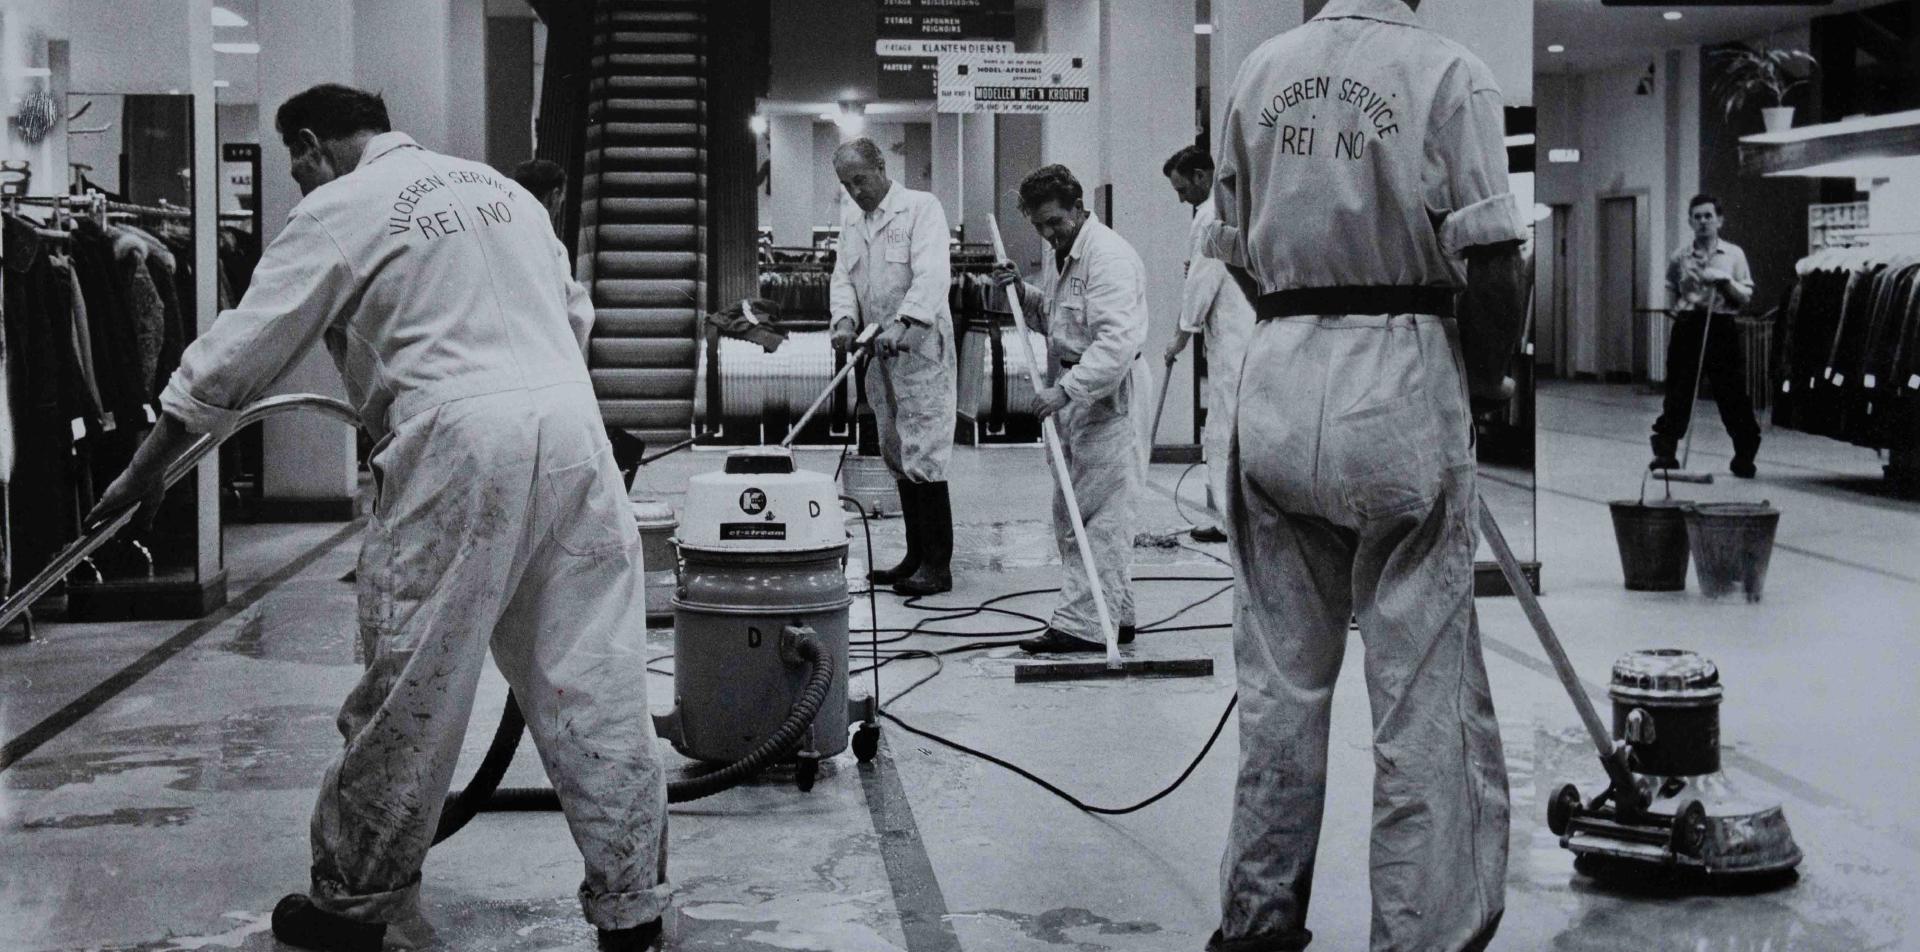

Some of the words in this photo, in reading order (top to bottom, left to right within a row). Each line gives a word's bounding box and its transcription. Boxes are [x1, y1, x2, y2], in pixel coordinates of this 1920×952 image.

[922, 44, 1007, 54] KLANTENDIENST
[975, 88, 1015, 100] MODELLEN
[1019, 88, 1035, 100] MET
[1050, 88, 1086, 100] KROONTJE
[1258, 76, 1330, 128] VLOEREN
[1335, 131, 1365, 160] NO
[389, 175, 445, 236] VLOEREN
[476, 201, 512, 227] NO
[808, 500, 821, 518] D
[748, 627, 762, 648] D
